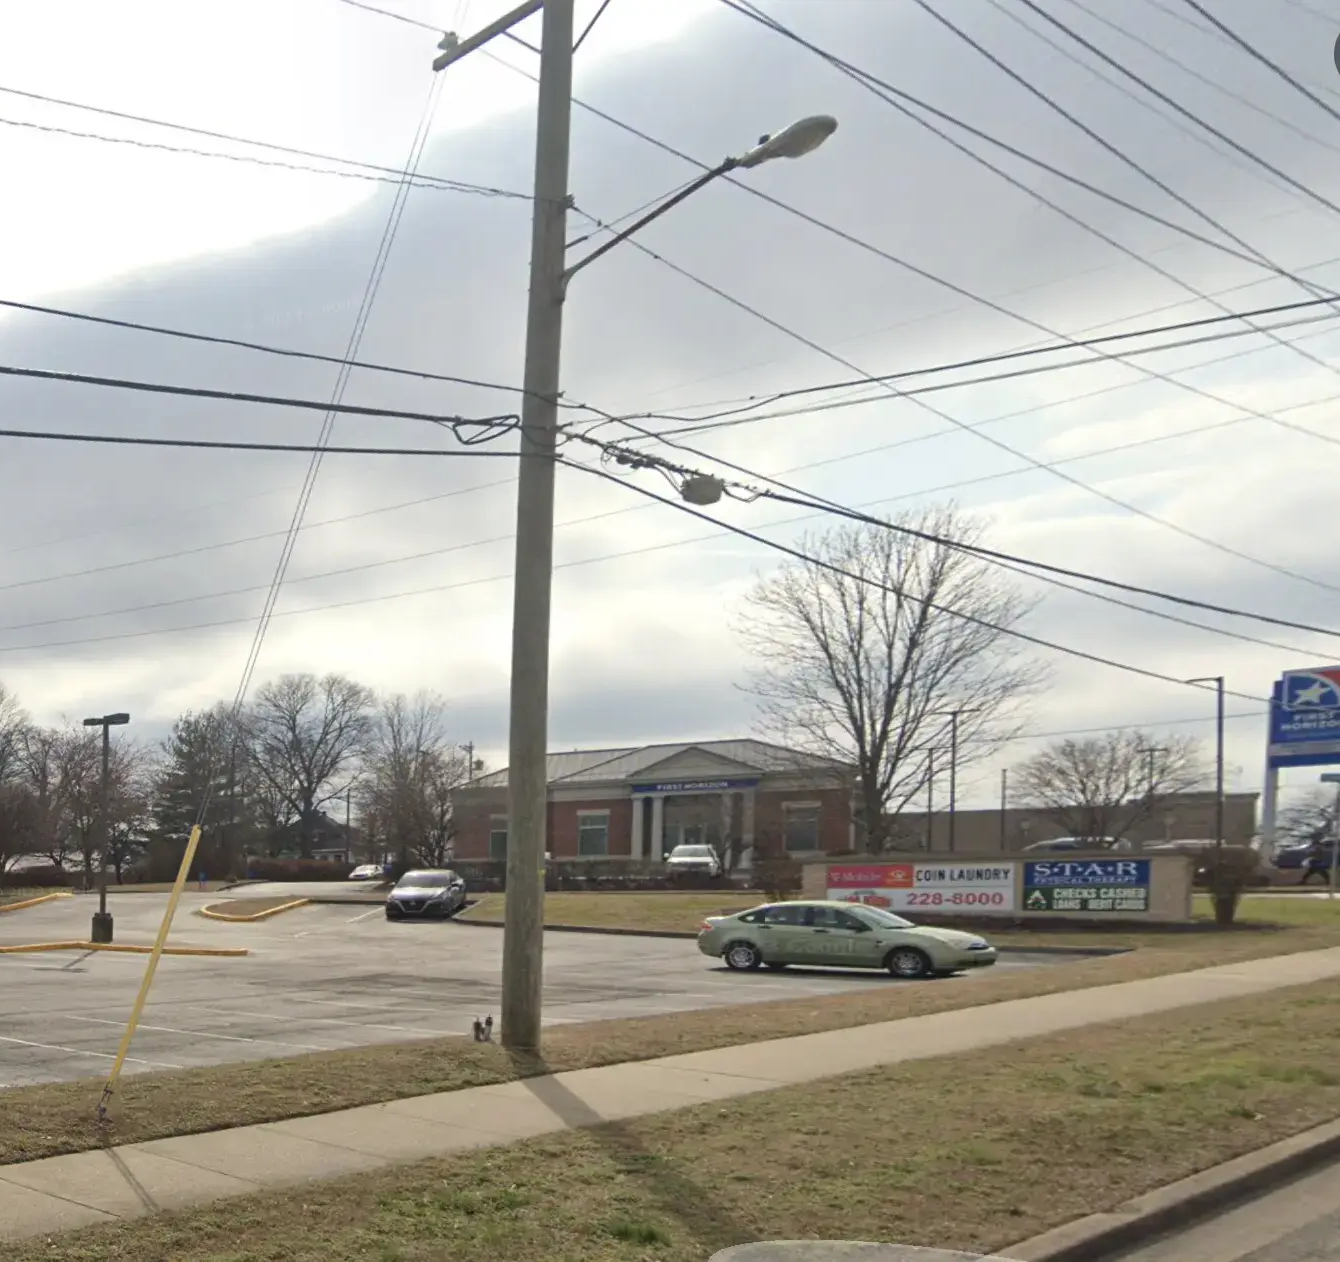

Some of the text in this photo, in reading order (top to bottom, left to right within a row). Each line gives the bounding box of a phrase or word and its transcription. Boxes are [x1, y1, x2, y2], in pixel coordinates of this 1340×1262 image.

[1281, 720, 1340, 730] HORIZO
[916, 868, 1010, 882] COIN LAUNDRY
[906, 892, 1004, 906] 228-8000
[1053, 888, 1146, 898] CHECKS CASHED
